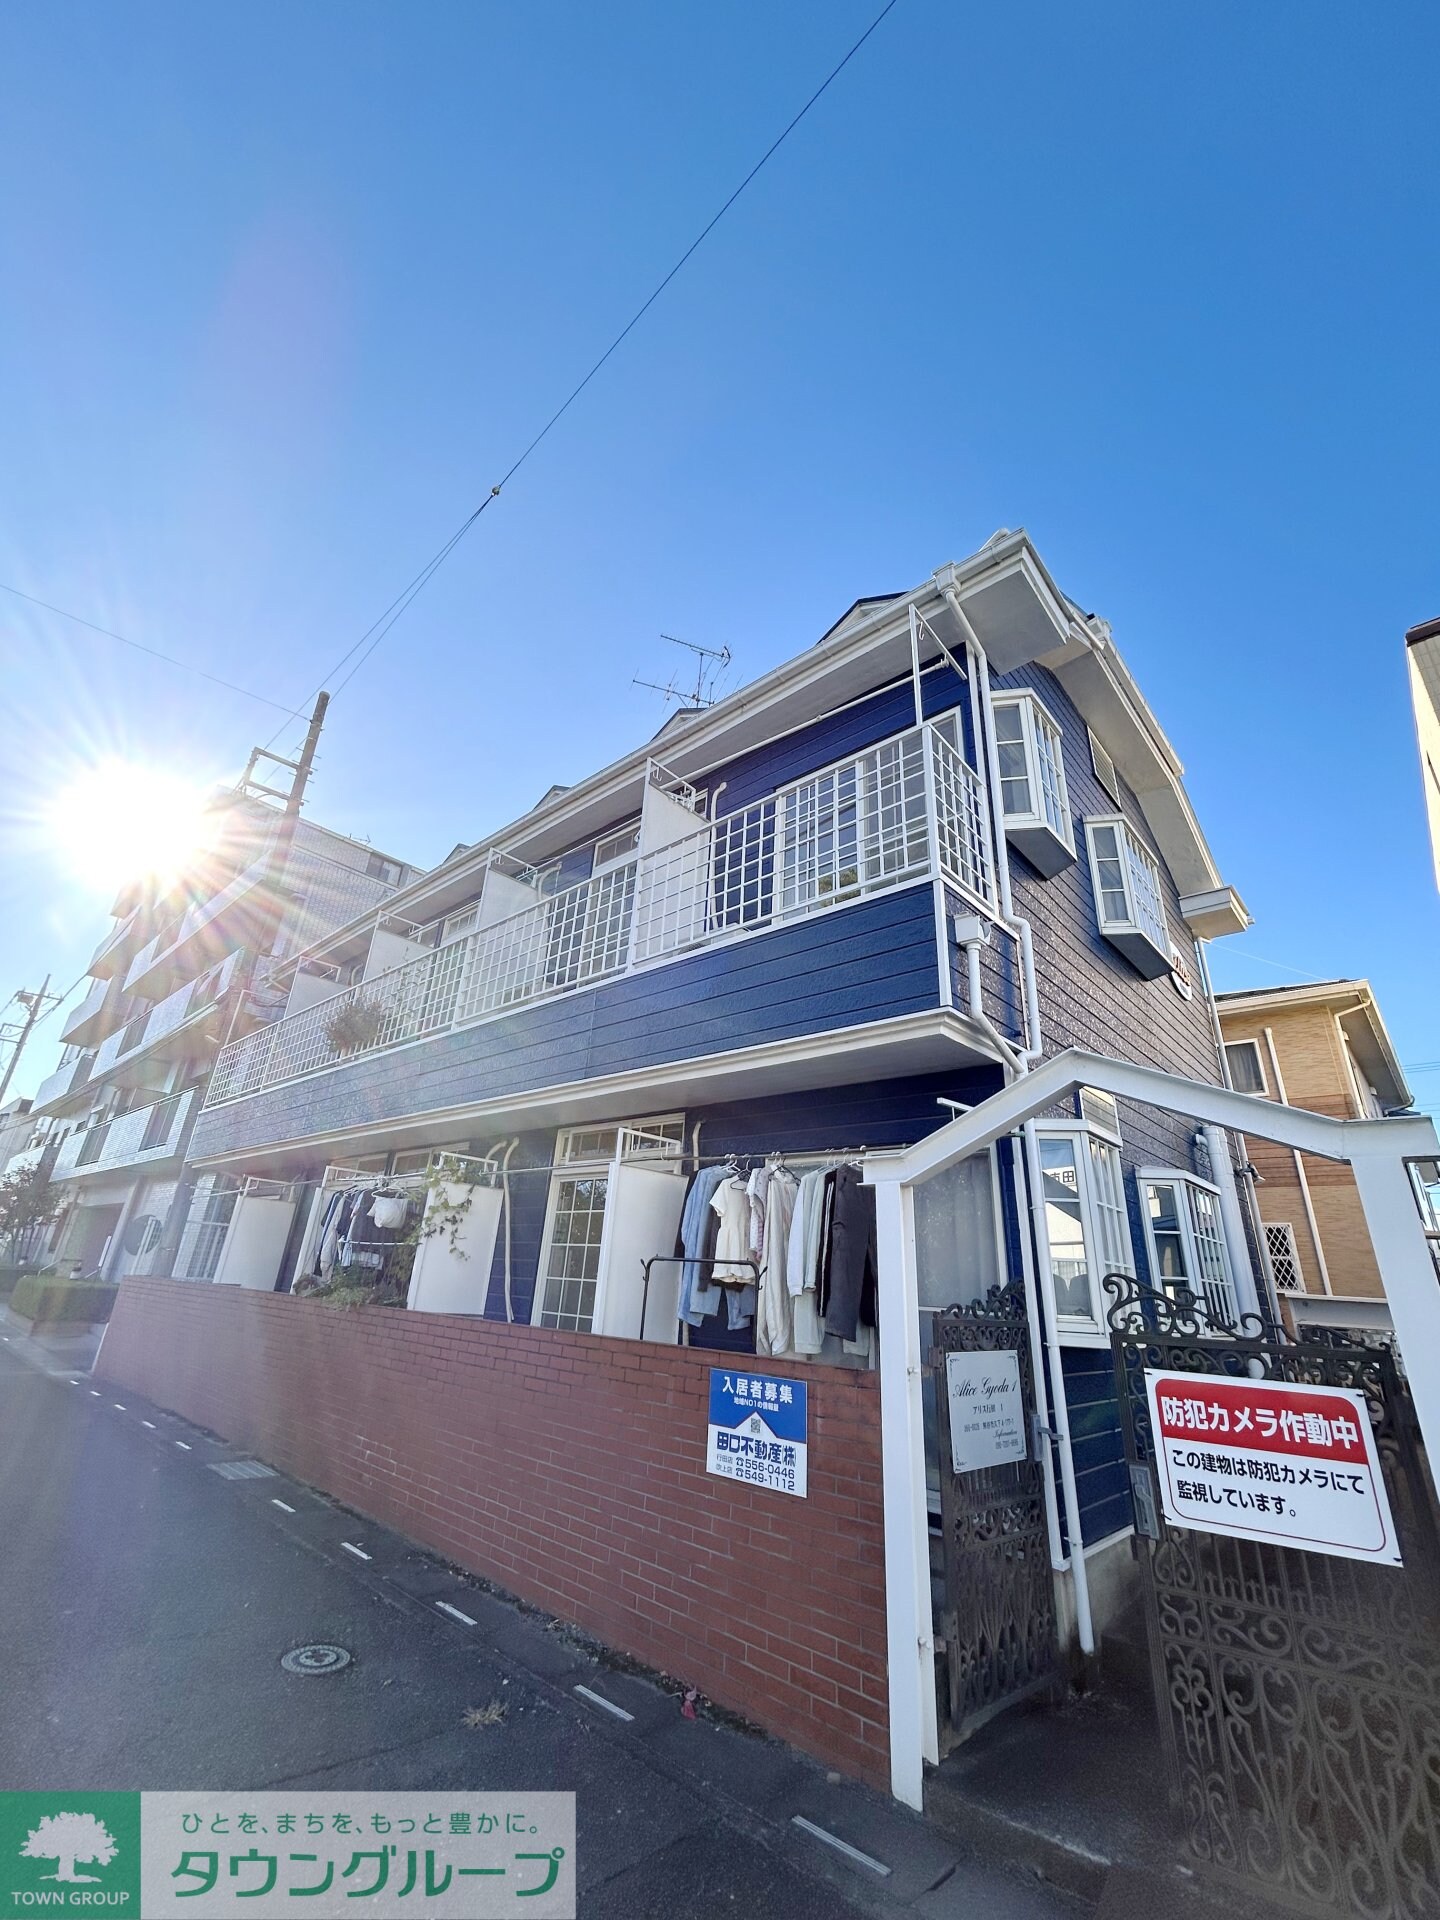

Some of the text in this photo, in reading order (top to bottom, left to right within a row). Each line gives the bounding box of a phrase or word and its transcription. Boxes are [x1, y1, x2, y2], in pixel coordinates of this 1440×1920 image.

[722, 1376, 793, 1404] 入居者募集
[953, 1379, 979, 1398] Alice
[981, 1377, 1009, 1400] Gyoda
[1160, 1396, 1359, 1449] 防犯カメラ作動中
[745, 1458, 795, 1479] 556-0446
[745, 1471, 795, 1491] 549-1112
[1172, 1449, 1365, 1494] この建物は防犯カメラにて
[1176, 1479, 1297, 1518] 監視しています。
